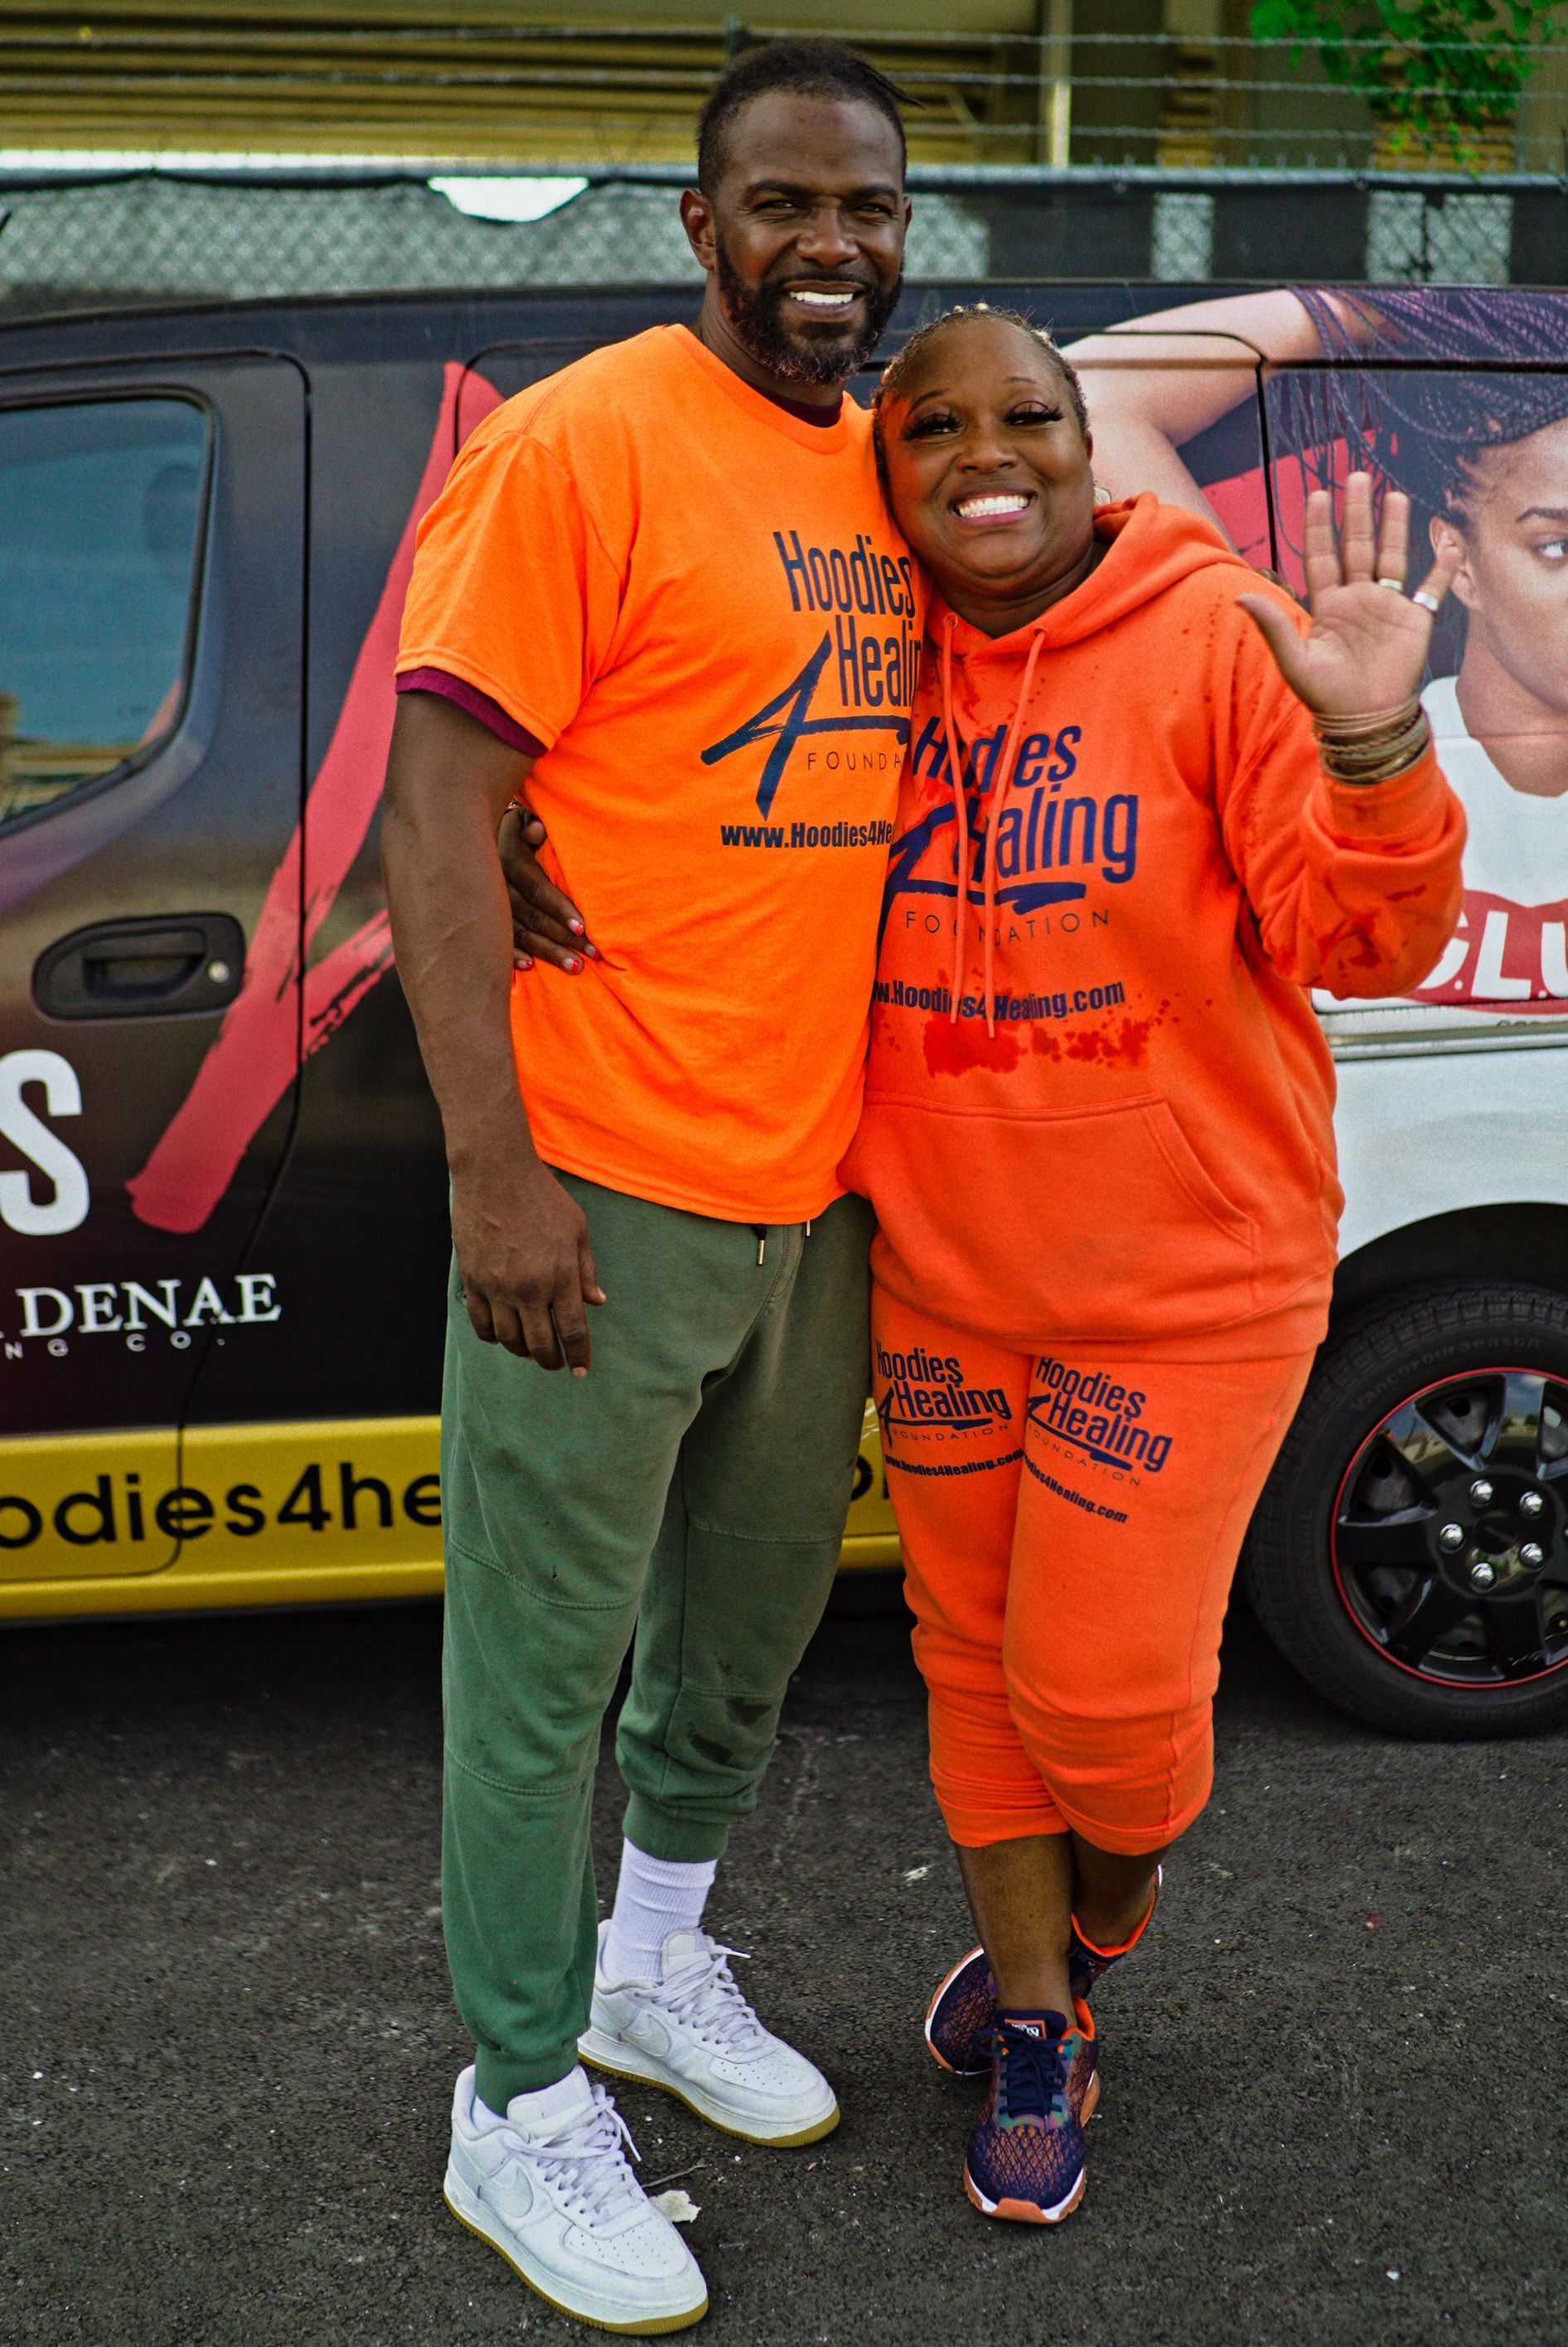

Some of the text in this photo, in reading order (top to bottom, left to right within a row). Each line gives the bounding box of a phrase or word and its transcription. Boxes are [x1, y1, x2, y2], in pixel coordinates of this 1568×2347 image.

[772, 530, 916, 619] Hoodies
[700, 630, 910, 821] 4
[806, 751, 902, 772] FOUNDA
[0, 1048, 90, 1236] S
[15, 1273, 283, 1338] DENAE
[876, 1339, 965, 1385] Hoodies
[1035, 1356, 1147, 1419] Hoodies
[893, 1424, 1009, 1441] FOUNDATION
[894, 1381, 1013, 1420] Healing
[1047, 1391, 1174, 1473] Healing
